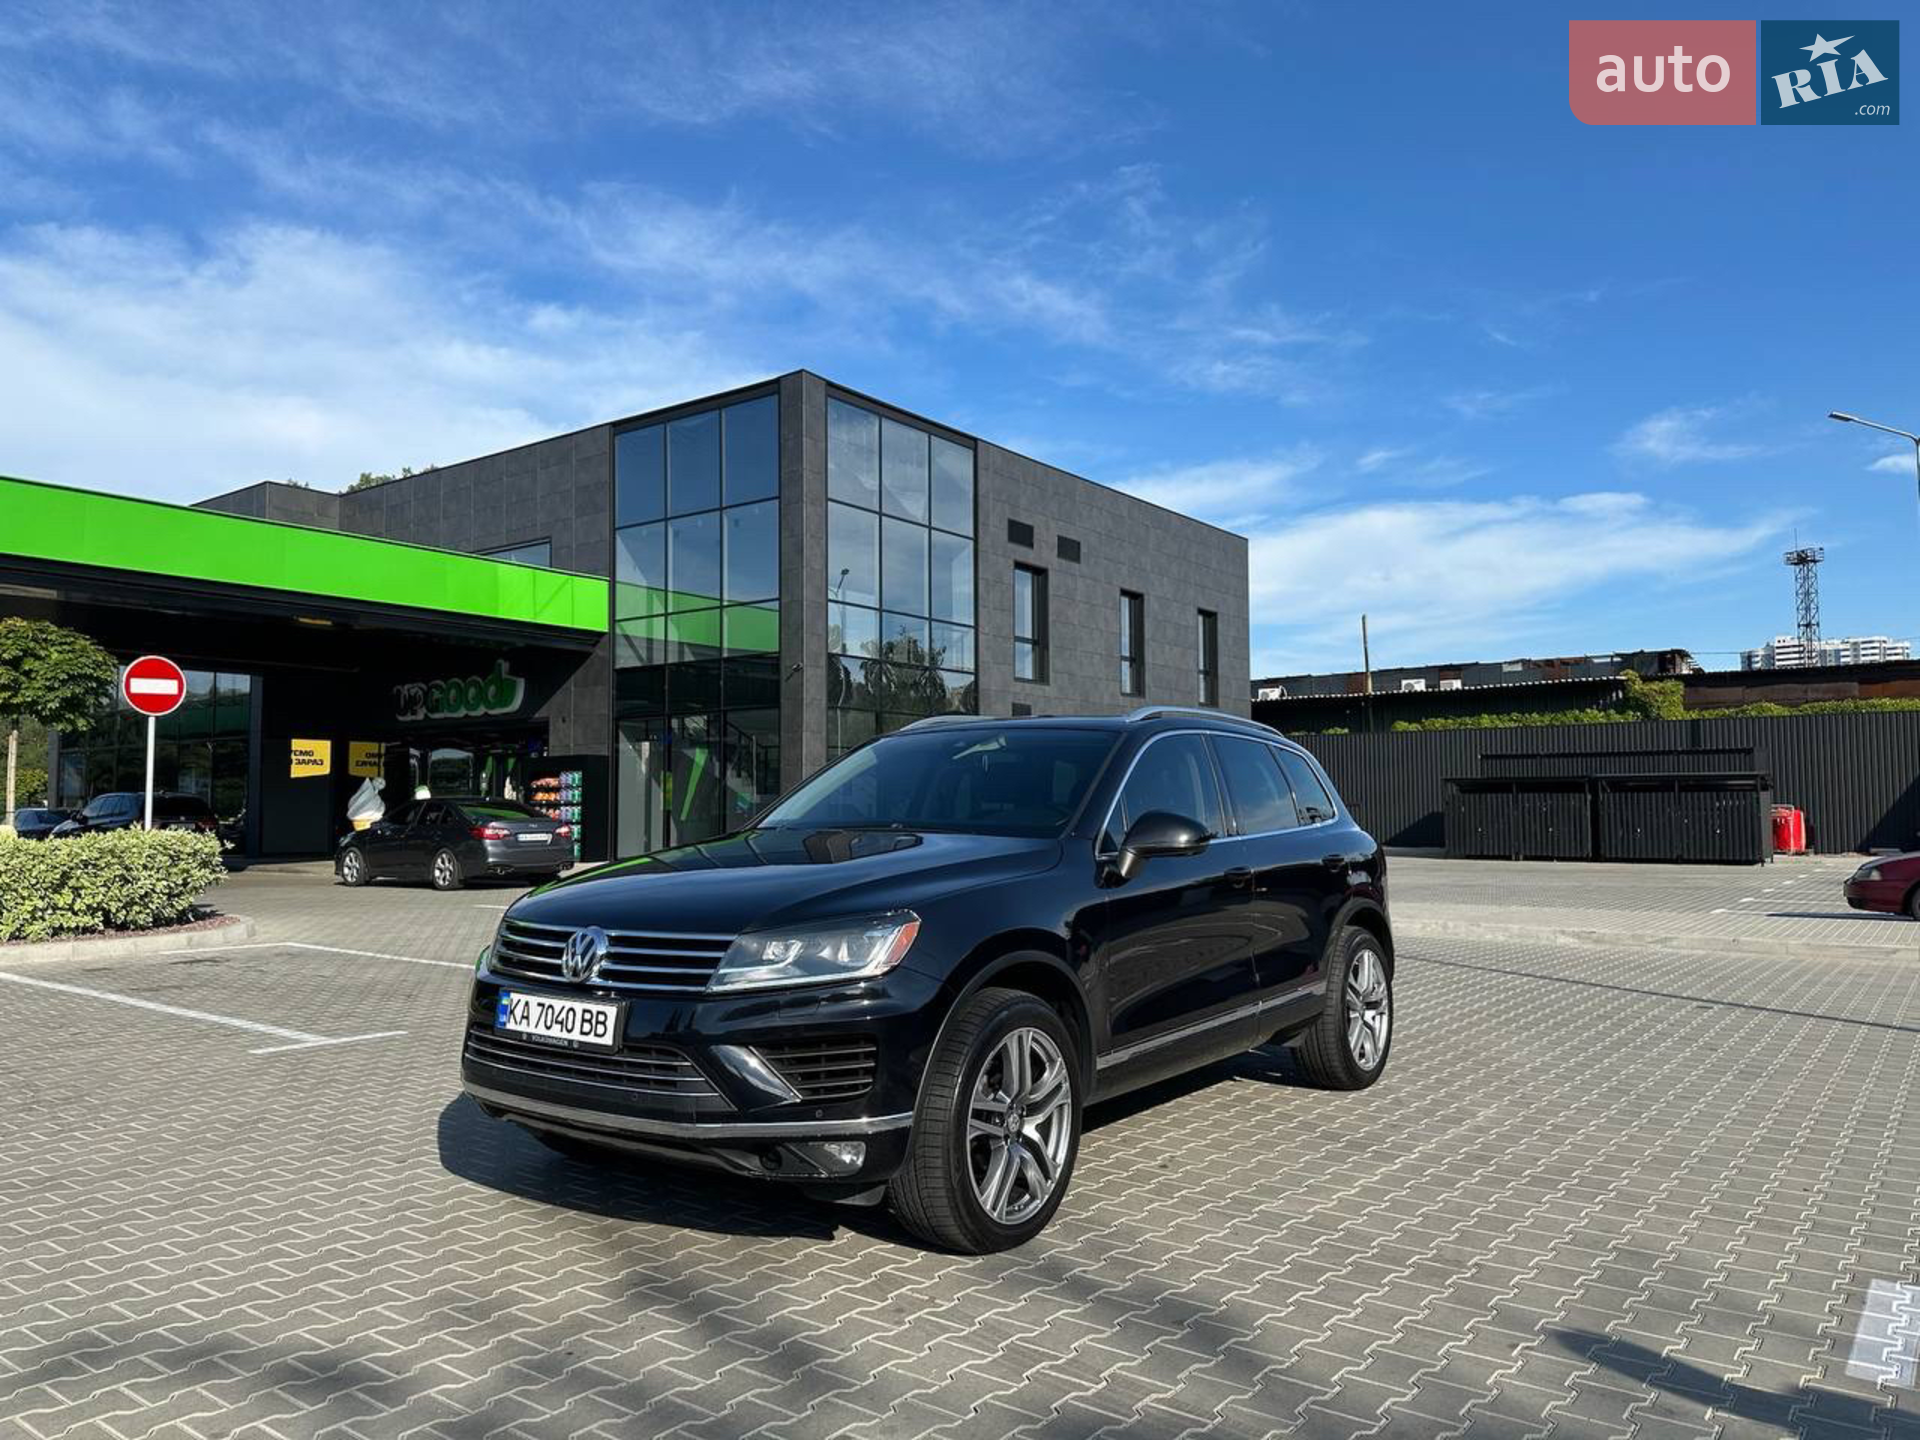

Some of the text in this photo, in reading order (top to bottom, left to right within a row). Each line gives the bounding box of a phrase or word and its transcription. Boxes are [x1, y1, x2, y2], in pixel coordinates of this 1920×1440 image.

[508, 998, 608, 1038] KA 7040 BB
